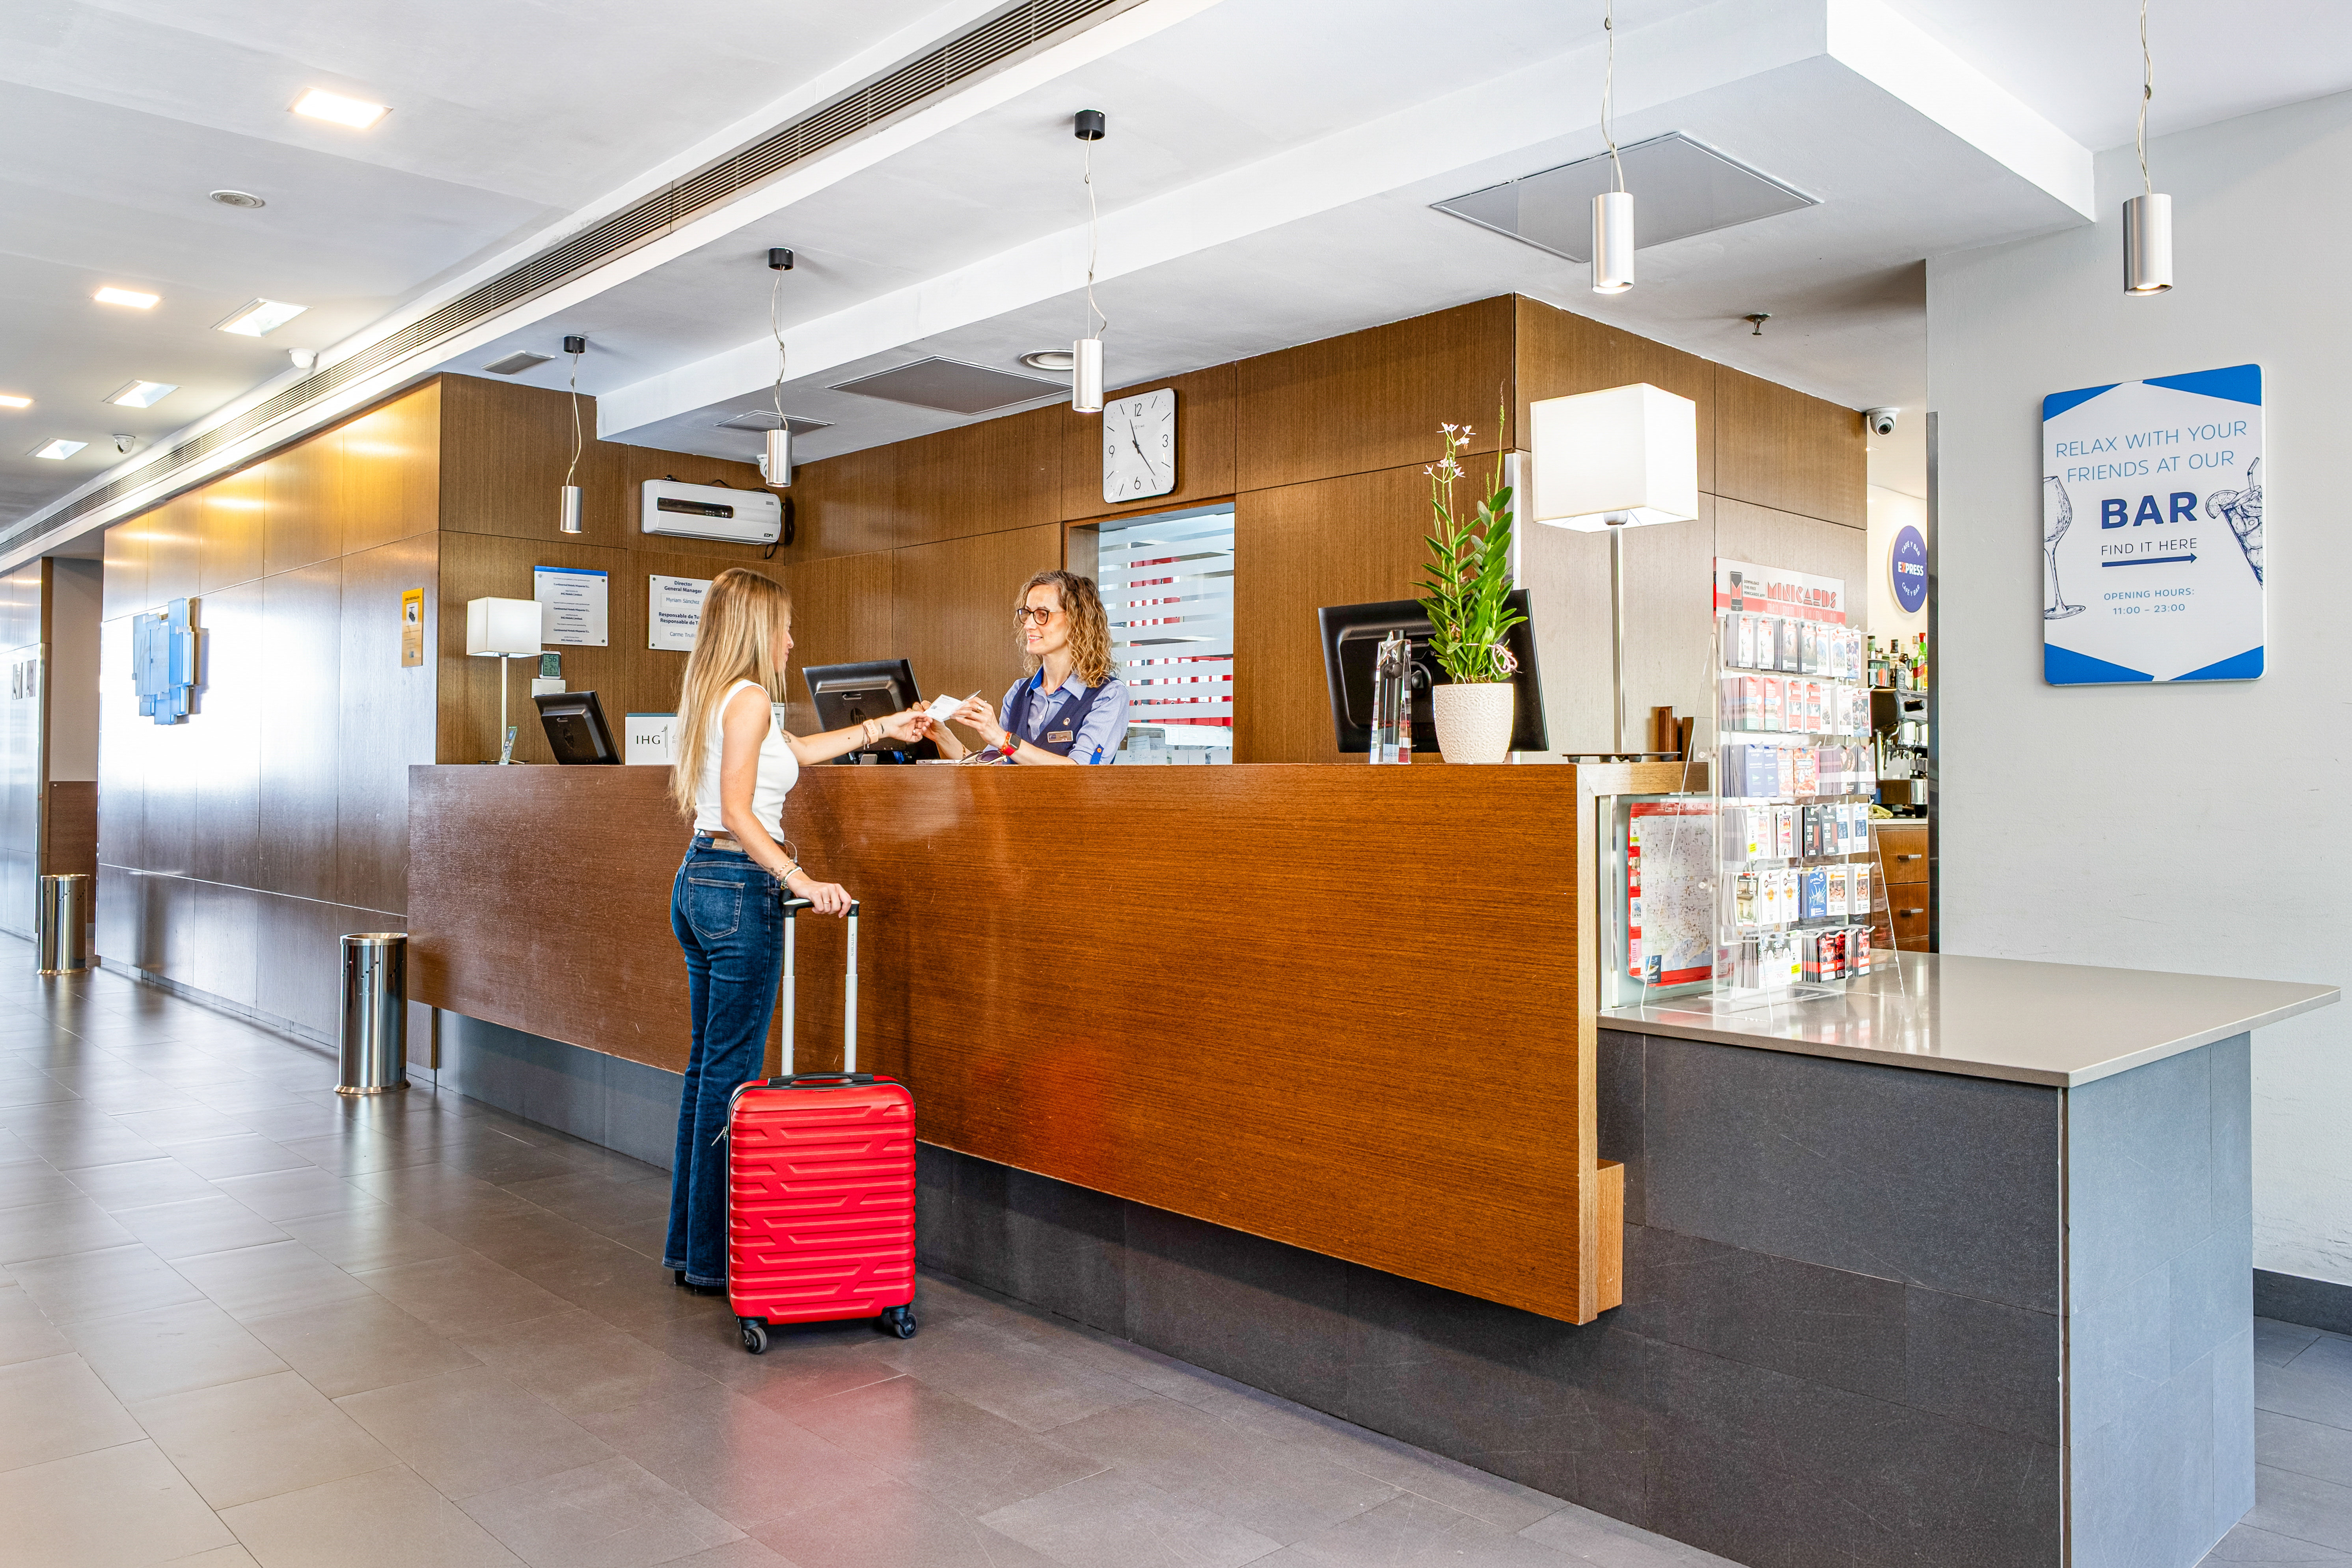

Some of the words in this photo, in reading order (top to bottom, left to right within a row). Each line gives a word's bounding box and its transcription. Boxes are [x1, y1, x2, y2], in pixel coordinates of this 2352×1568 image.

[1135, 403, 1142, 417] 12
[1162, 434, 1168, 447] 3
[2056, 436, 2117, 457] RELAX
[2126, 429, 2179, 449] WITH
[2188, 421, 2247, 442] YOUR
[1109, 445, 1115, 458] 9
[2068, 460, 2149, 483] FRIENDS
[2157, 457, 2180, 473] AT
[2188, 451, 2233, 469] OUR
[1134, 476, 1141, 490] 6
[2102, 492, 2197, 529] BAR
[2102, 542, 2134, 556] FIND
[2140, 541, 2152, 552] IT
[2160, 538, 2197, 551] HERE
[1898, 561, 1923, 576] EXPRESS
[1767, 582, 1837, 608] MINICARDS
[2104, 591, 2150, 600] OPENING
[2155, 588, 2195, 598] HOURS:
[2113, 606, 2140, 615] 11:00
[2154, 604, 2185, 613] 23:00
[636, 735, 660, 744] IHG
